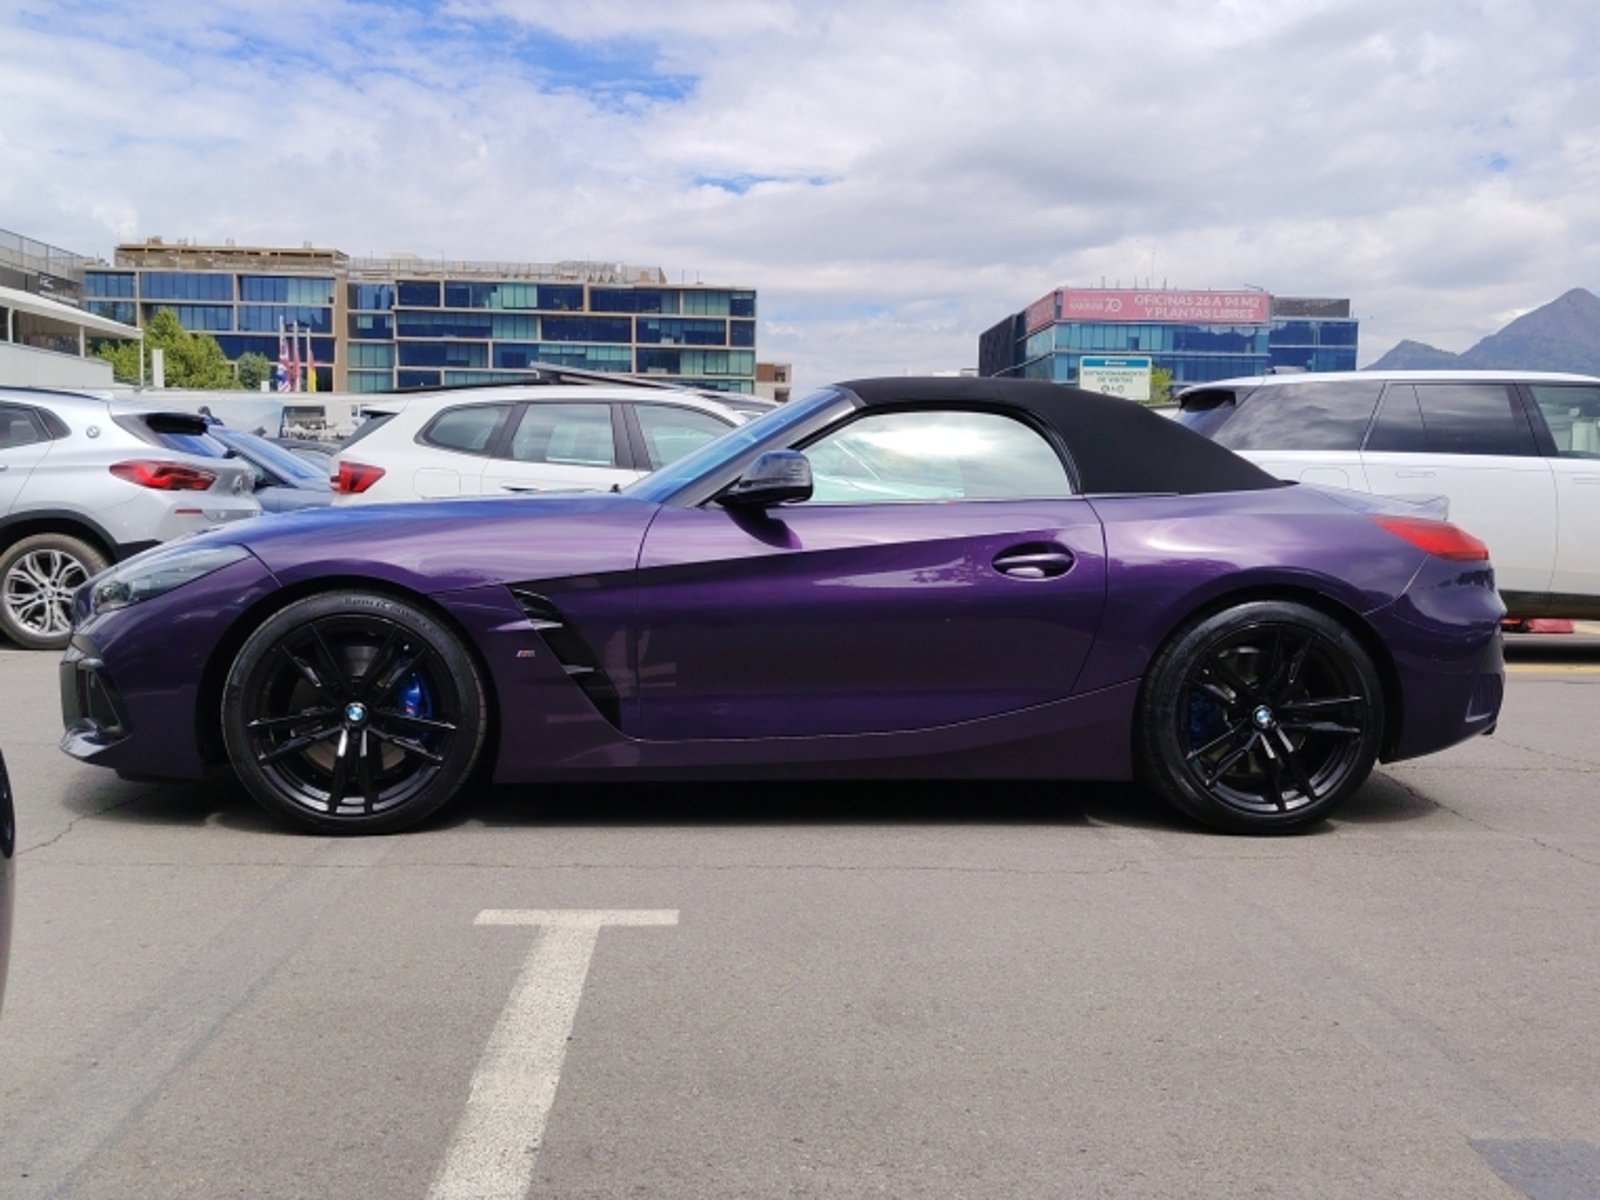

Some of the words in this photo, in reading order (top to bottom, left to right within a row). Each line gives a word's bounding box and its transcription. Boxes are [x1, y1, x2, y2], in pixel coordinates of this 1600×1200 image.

[1134, 294, 1194, 306] OFICINAS
[1195, 296, 1210, 306] 26
[1212, 296, 1222, 307] A
[1224, 297, 1238, 307] 94
[1144, 307, 1153, 317] Y
[1155, 307, 1210, 318] PLANTAS
[1212, 308, 1254, 319] LIBRES
